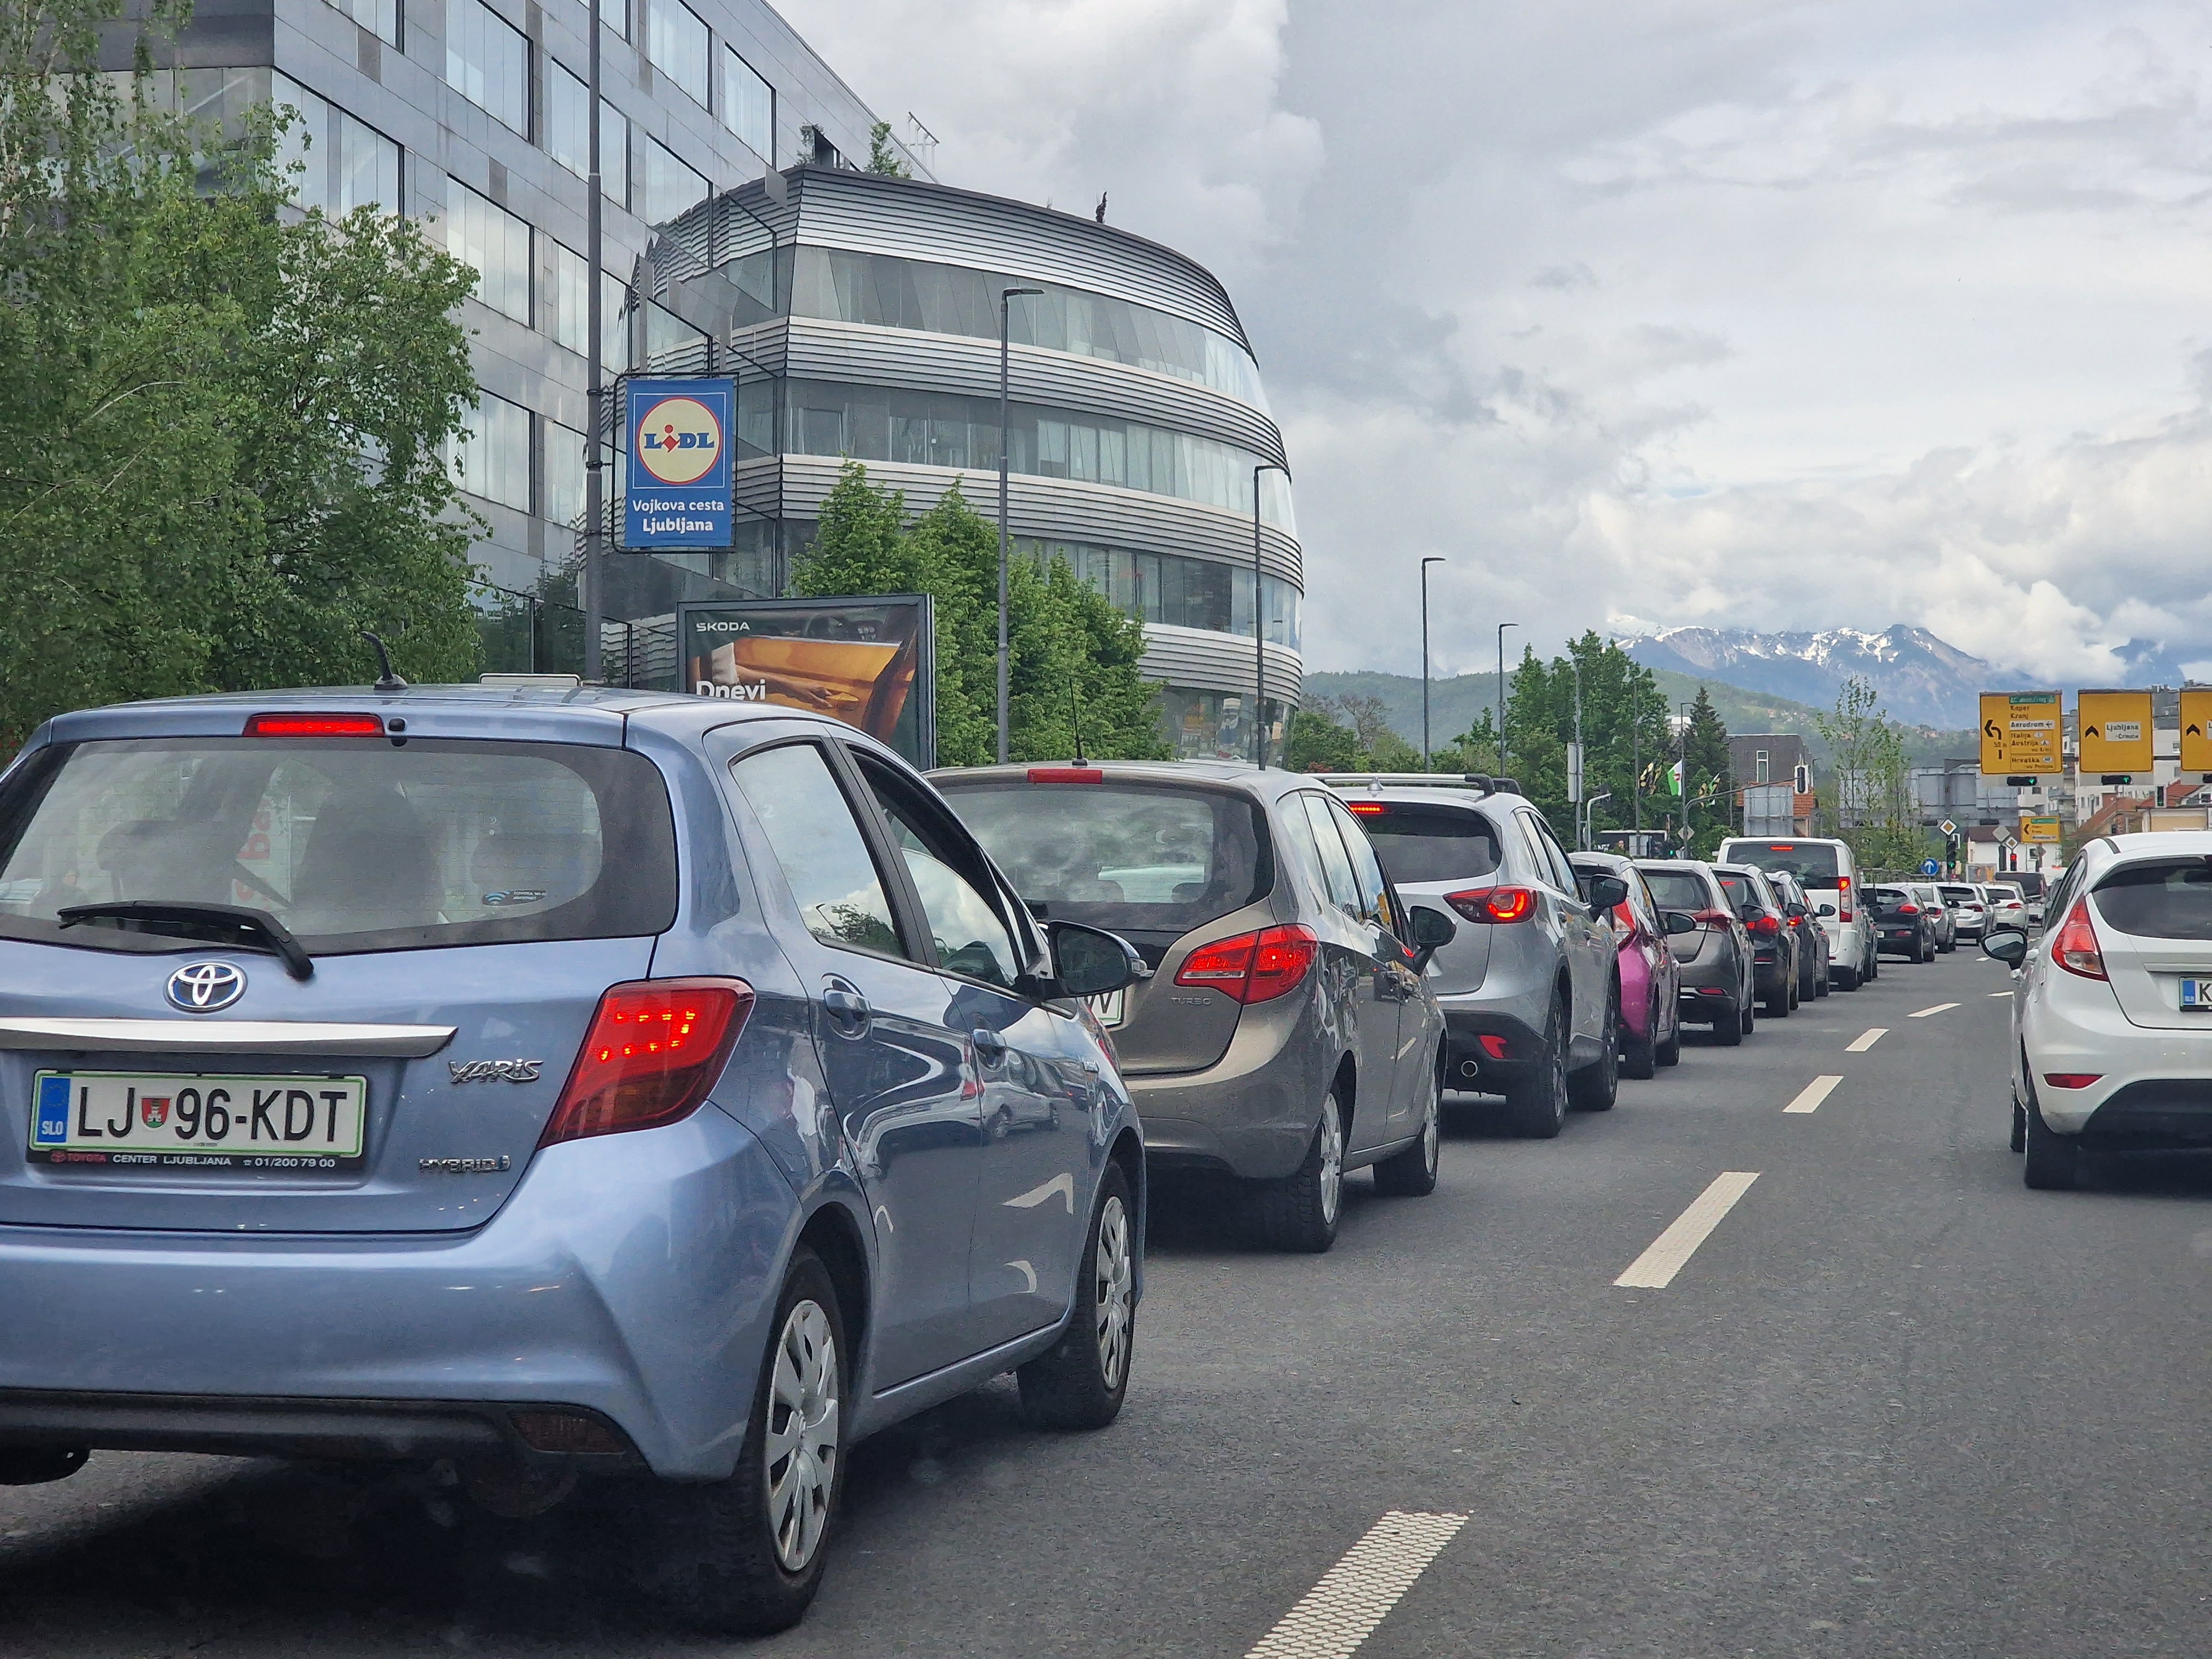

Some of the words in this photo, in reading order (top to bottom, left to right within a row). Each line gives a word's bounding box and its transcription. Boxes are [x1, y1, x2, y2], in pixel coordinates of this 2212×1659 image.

[633, 499, 685, 513] Vojkova
[689, 500, 724, 512] cesta
[643, 518, 714, 535] Ljubljana
[696, 679, 766, 700] Dnevi
[41, 1120, 64, 1135] SLO
[67, 1153, 107, 1162] TOYOTA
[112, 1154, 158, 1164] CENTER
[163, 1155, 232, 1166] LJUBLJANA
[254, 1157, 298, 1167] 01/200
[300, 1159, 317, 1167] 79
[319, 1159, 336, 1168] 00
